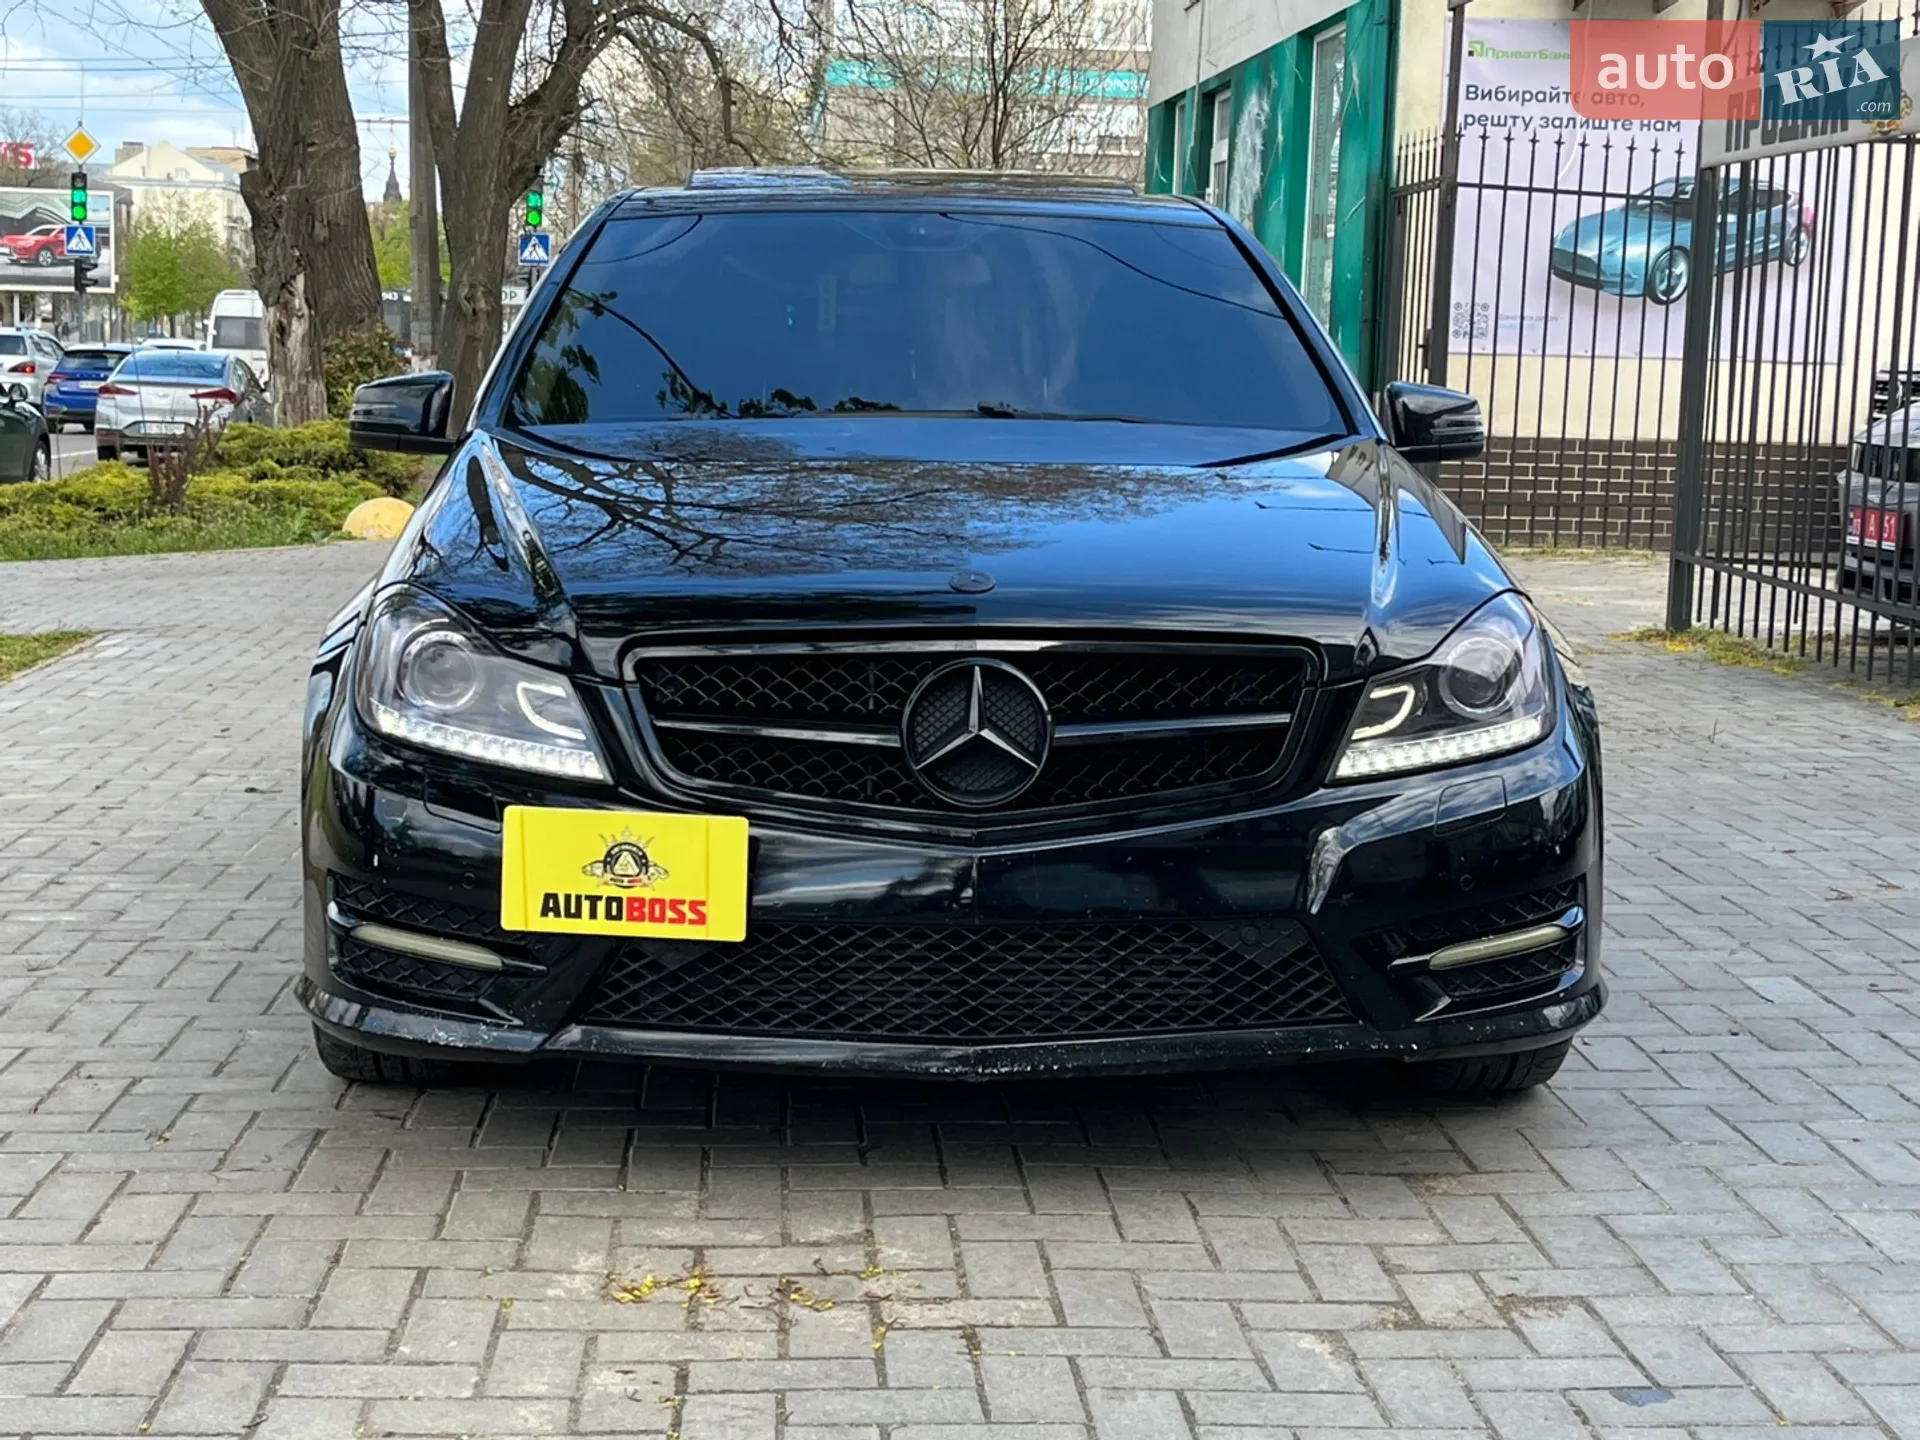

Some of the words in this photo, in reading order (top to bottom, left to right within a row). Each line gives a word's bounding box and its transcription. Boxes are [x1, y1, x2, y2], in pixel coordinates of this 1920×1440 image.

[1465, 84, 1581, 106] Вибирайте
[1591, 91, 1646, 108] авто,
[1463, 113, 1534, 132] решту
[1539, 115, 1634, 132] залиште
[1639, 119, 1682, 133] нам
[540, 893, 707, 925] AUTOBOSS
